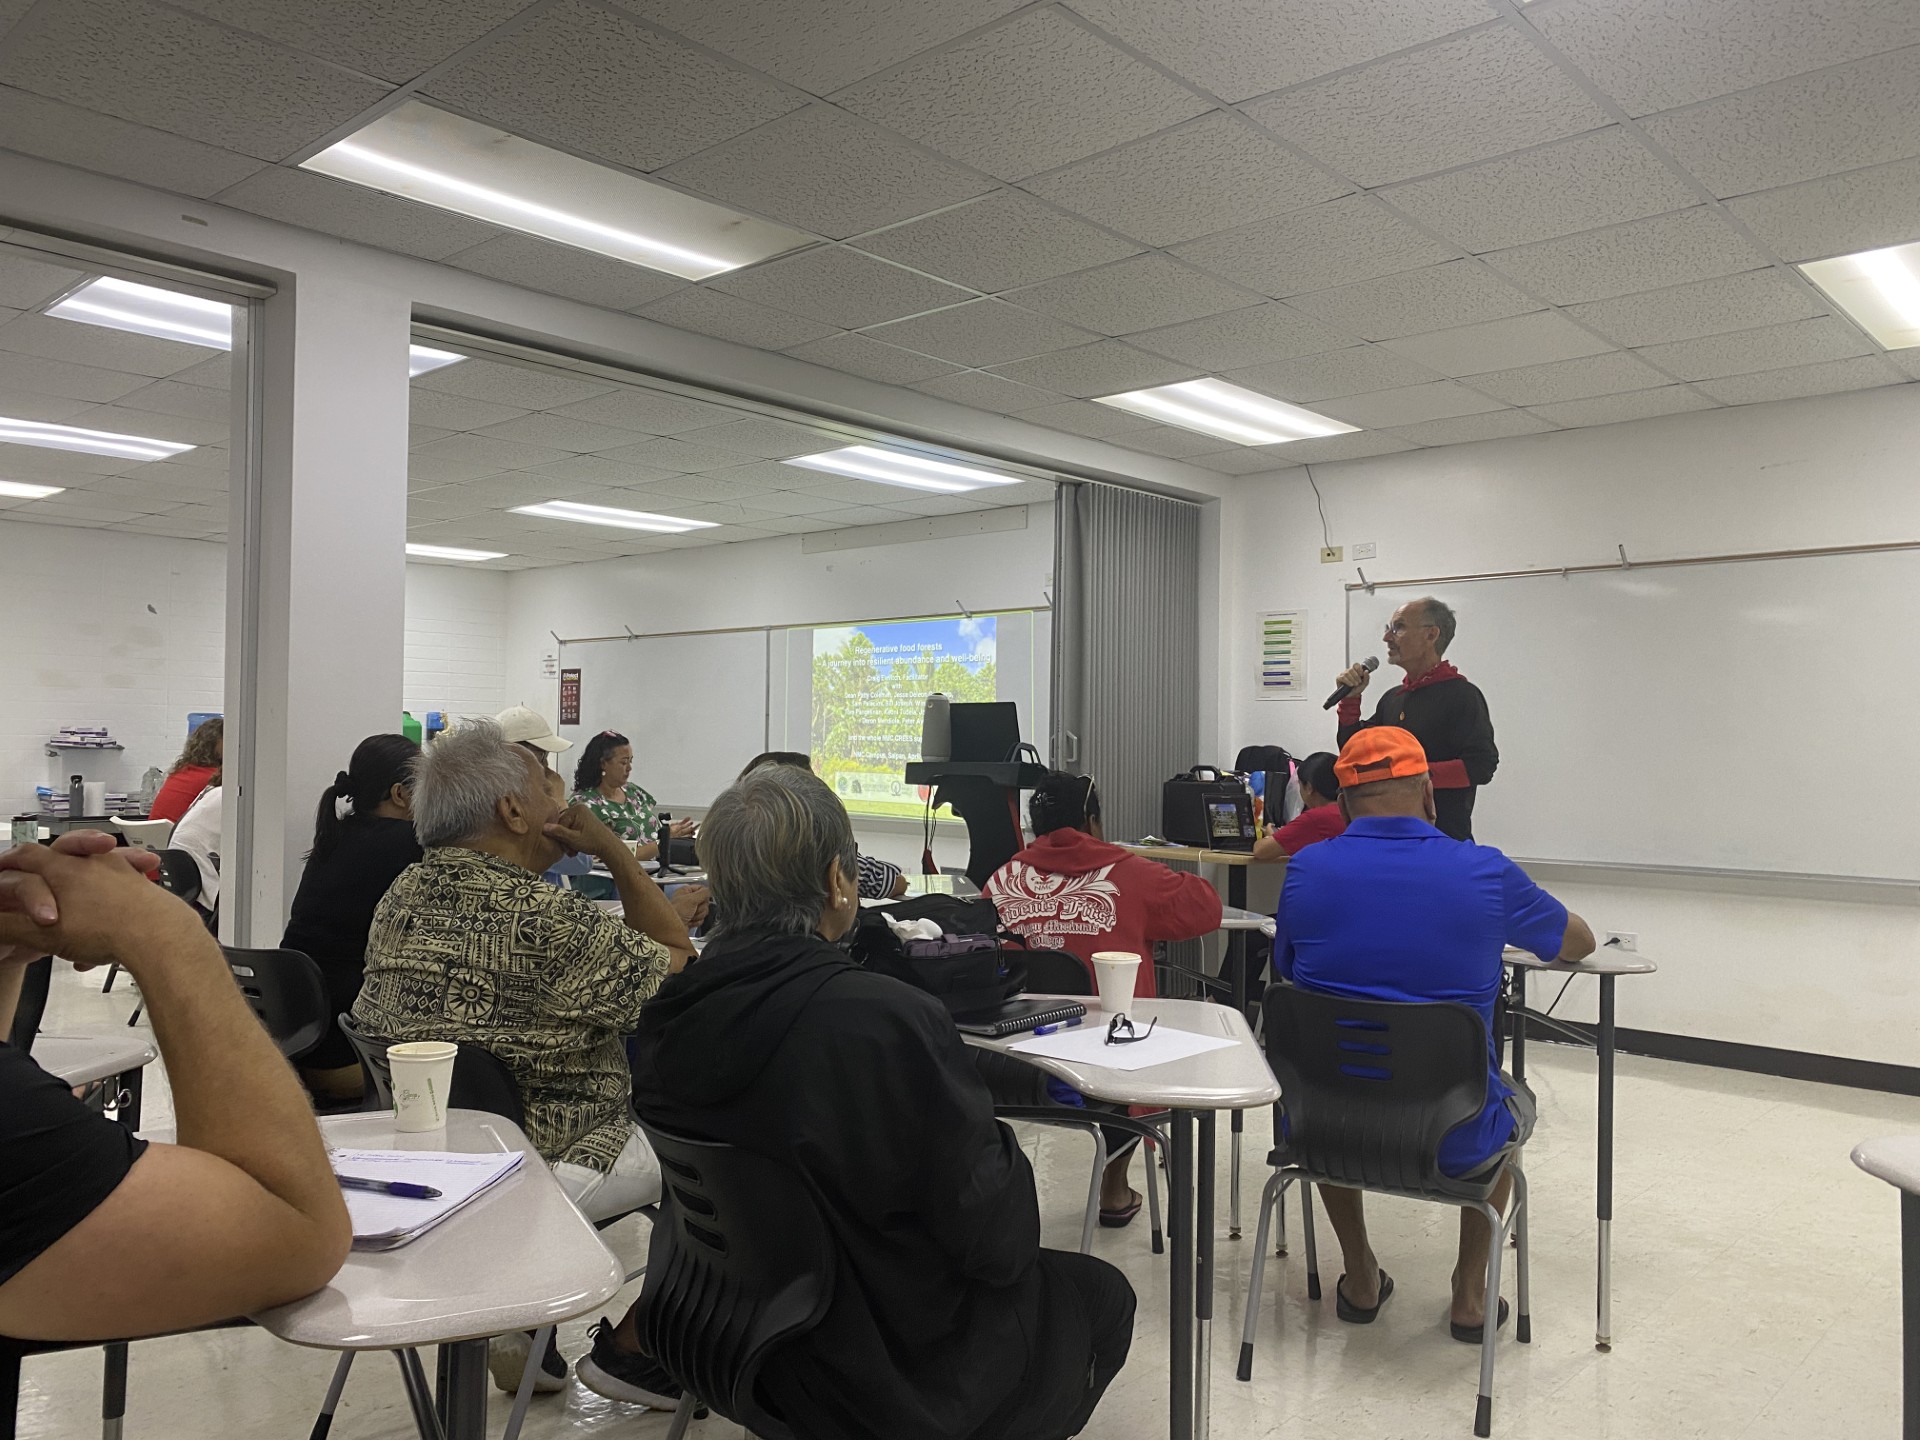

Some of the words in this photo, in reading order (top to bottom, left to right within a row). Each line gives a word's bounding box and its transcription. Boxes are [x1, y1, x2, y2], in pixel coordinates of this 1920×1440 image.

[855, 645, 898, 656] Regenerative
[900, 643, 915, 653] food
[918, 642, 943, 652] forests
[828, 660, 851, 669] journey
[853, 658, 866, 666] into
[867, 657, 893, 666] resilient
[896, 655, 933, 665] abundance
[936, 653, 950, 663] and
[952, 652, 991, 664] well-being
[1060, 900, 1117, 931] First
